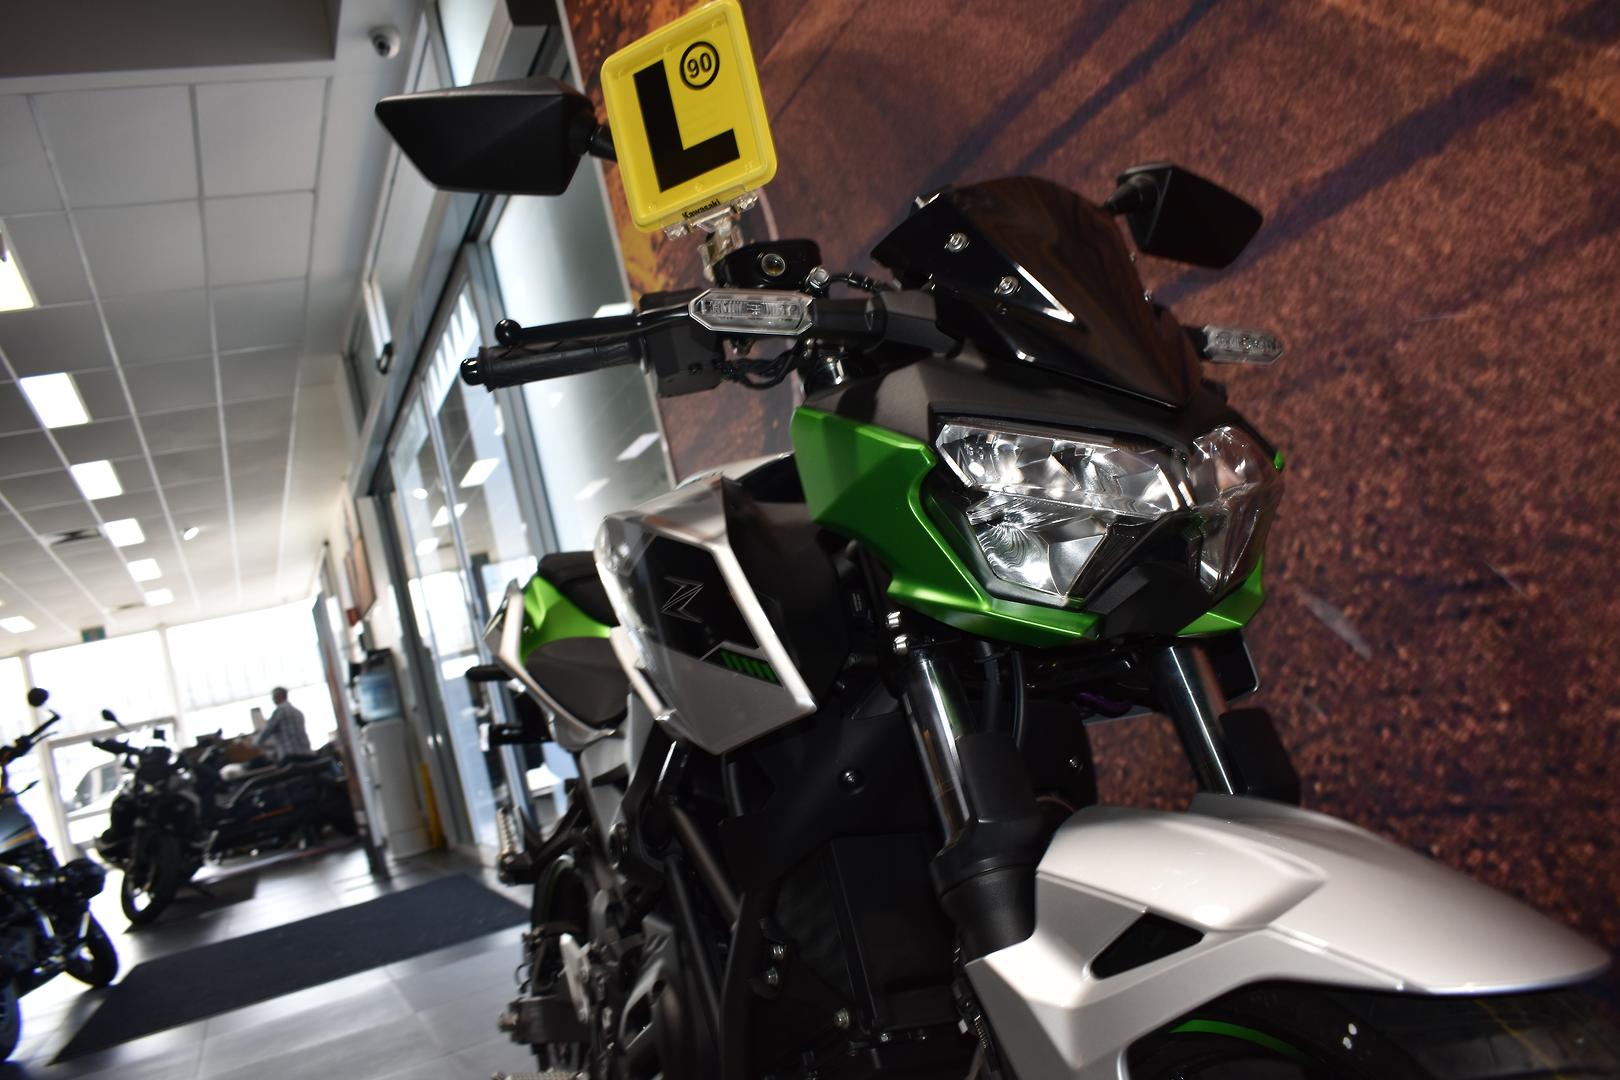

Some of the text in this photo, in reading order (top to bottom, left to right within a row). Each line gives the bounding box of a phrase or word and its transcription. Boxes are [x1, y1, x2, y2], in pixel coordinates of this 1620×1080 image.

[687, 52, 712, 79] 90
[633, 59, 741, 193] L
[682, 199, 721, 219] Kawasaki
